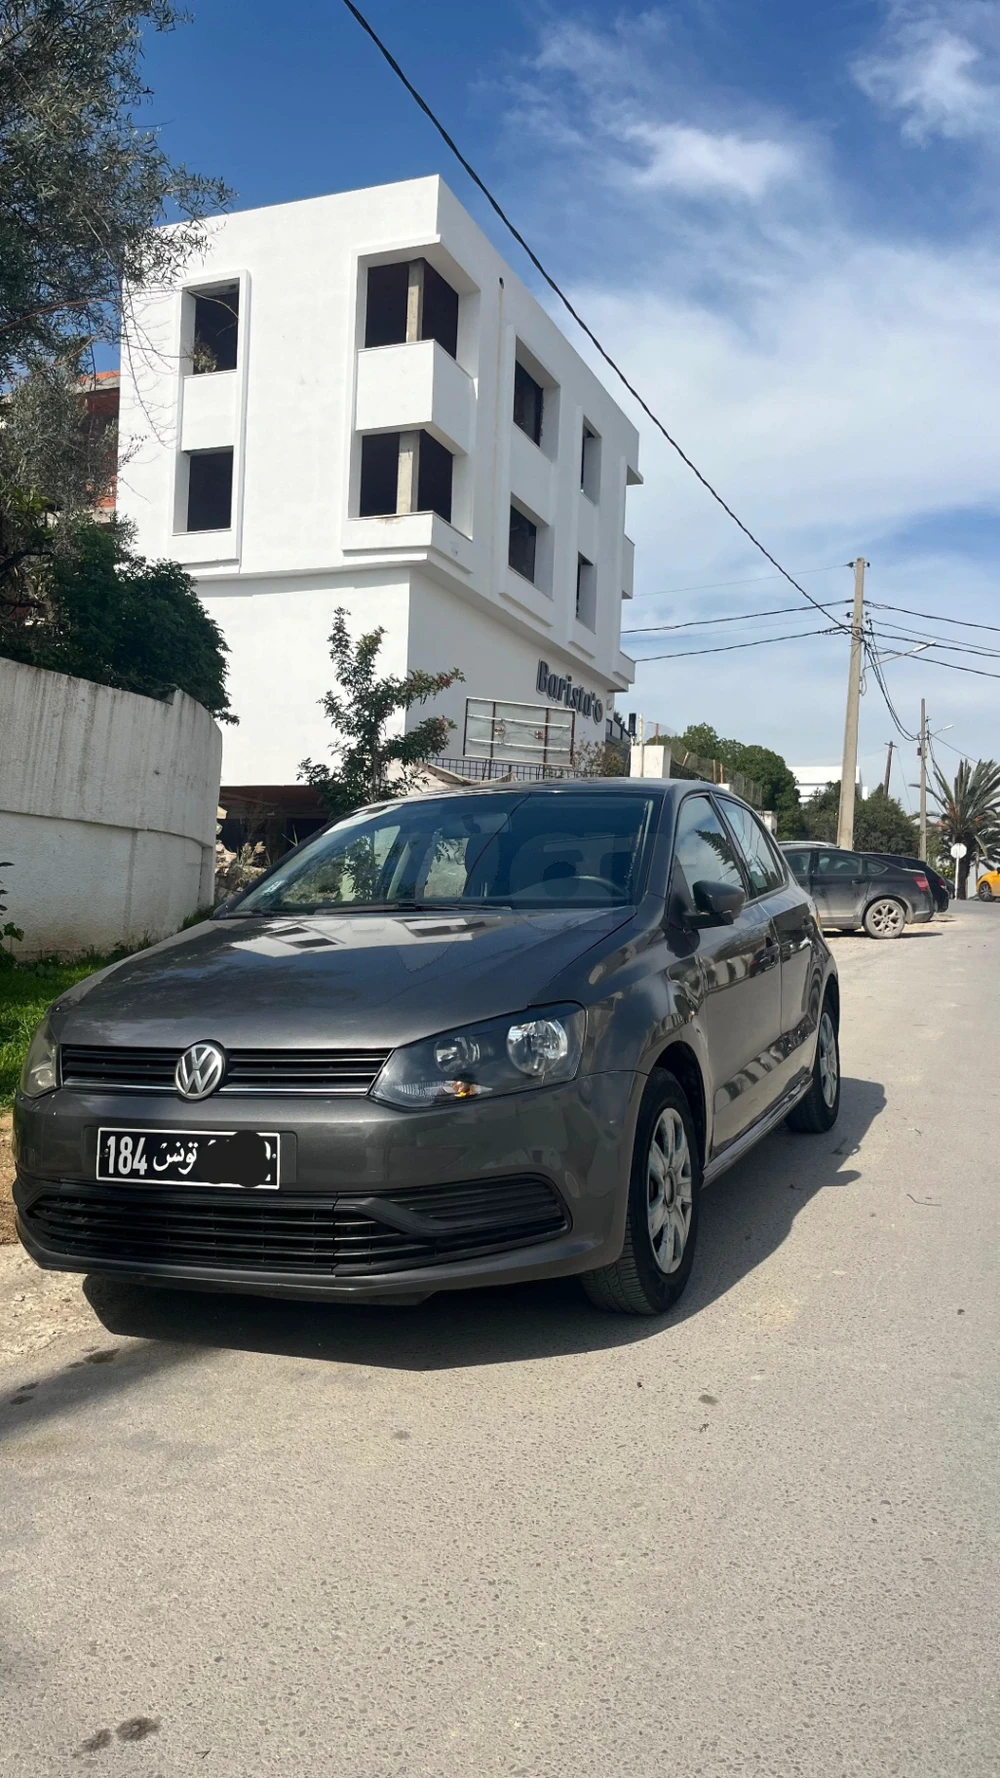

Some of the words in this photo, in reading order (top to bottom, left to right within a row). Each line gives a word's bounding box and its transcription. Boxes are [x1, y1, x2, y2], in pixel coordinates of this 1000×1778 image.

[176, 1043, 224, 1099] VW
[107, 1136, 147, 1175] 184
[153, 1141, 199, 1175] تونس
